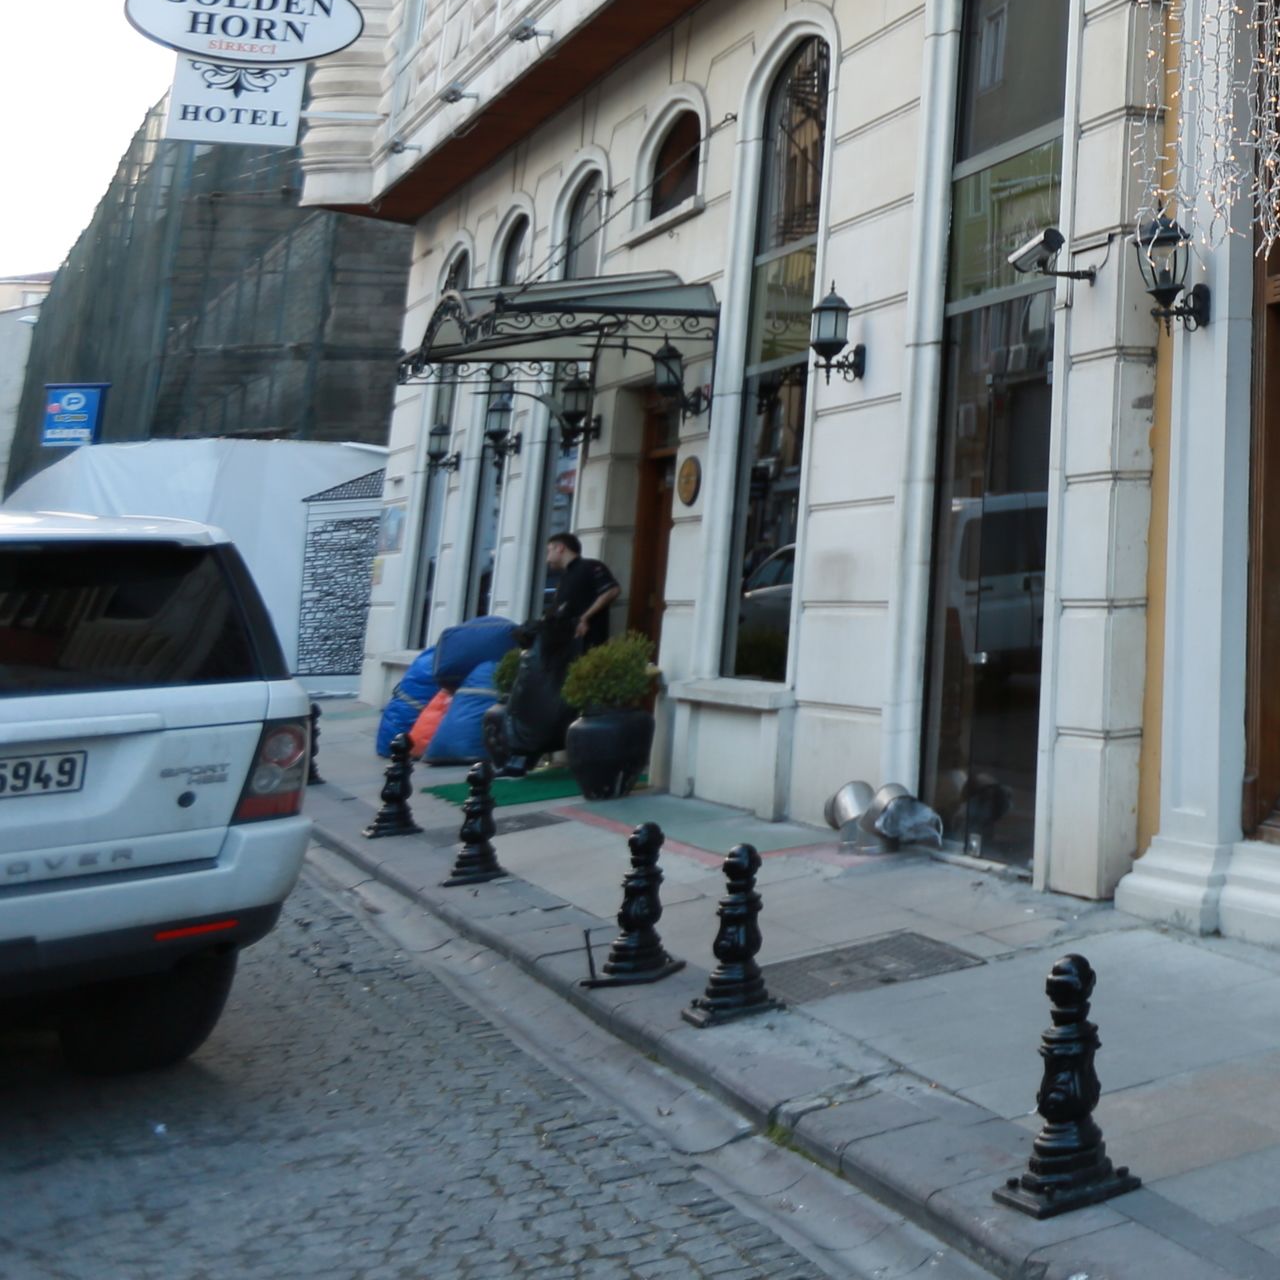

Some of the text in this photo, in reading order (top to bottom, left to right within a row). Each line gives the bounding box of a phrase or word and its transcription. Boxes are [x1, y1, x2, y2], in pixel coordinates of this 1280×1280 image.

[185, 10, 310, 44] HORN
[178, 103, 288, 127] HOTEL
[160, 763, 231, 778] SPORT
